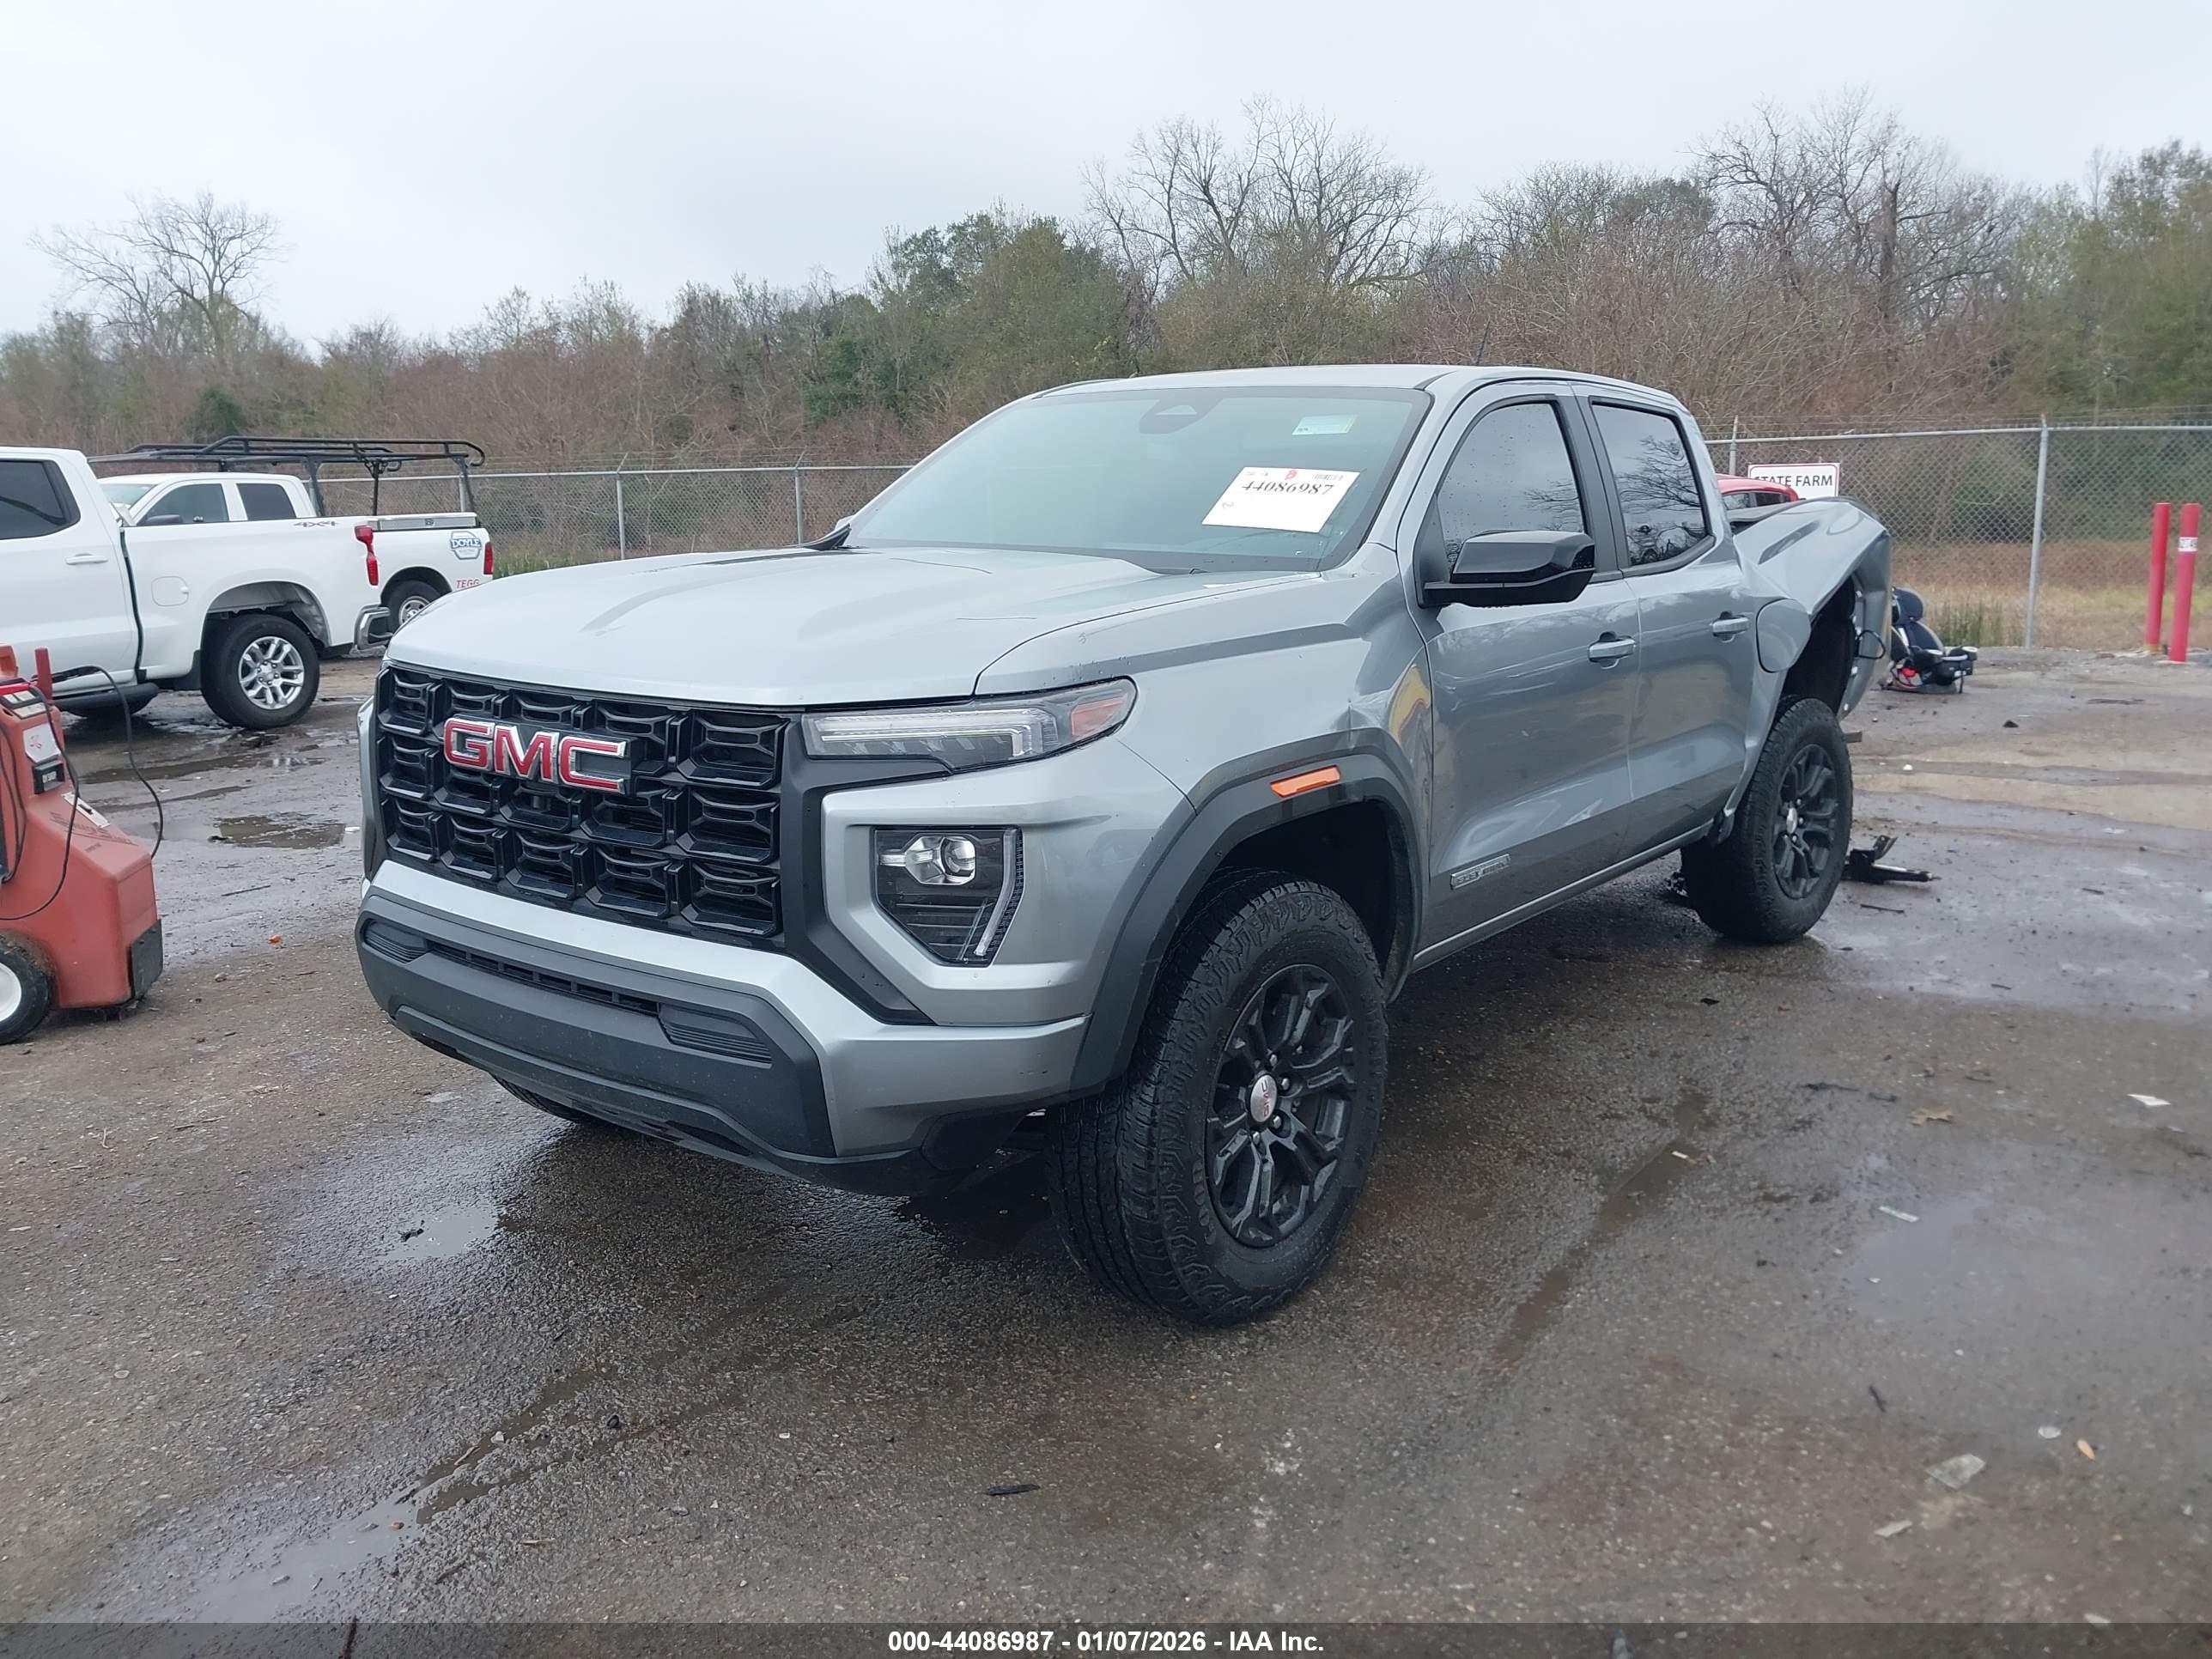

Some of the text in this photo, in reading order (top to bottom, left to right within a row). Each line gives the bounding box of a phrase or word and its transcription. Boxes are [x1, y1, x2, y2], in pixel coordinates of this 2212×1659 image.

[1242, 480, 1335, 495] 44086987
[1754, 475, 1833, 487] ATE FARM
[452, 538, 482, 548] DOYLE
[444, 716, 626, 794] GMC
